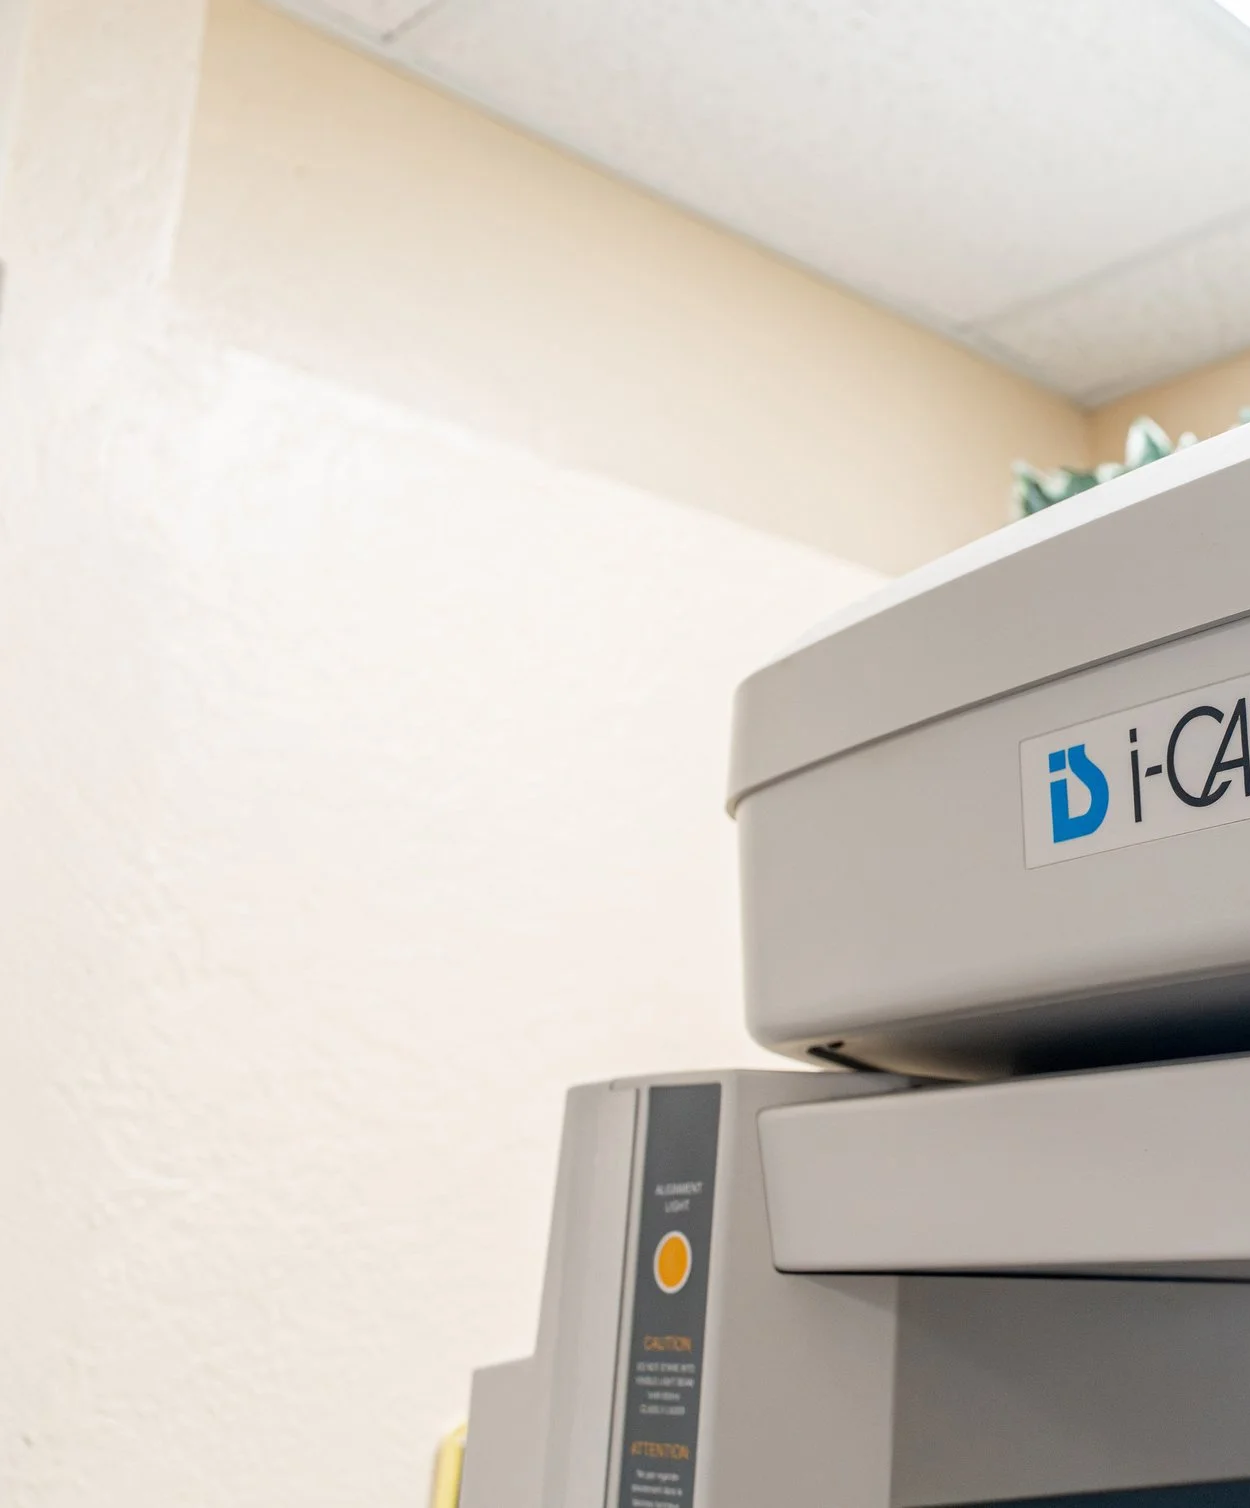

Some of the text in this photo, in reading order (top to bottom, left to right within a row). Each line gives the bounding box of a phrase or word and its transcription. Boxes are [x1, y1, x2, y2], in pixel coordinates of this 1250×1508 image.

[655, 1182, 703, 1196] ALIGNMENT
[664, 1199, 690, 1213] LIGHT
[643, 1335, 692, 1352] CAUTION
[630, 1441, 690, 1460] ATTENTION
